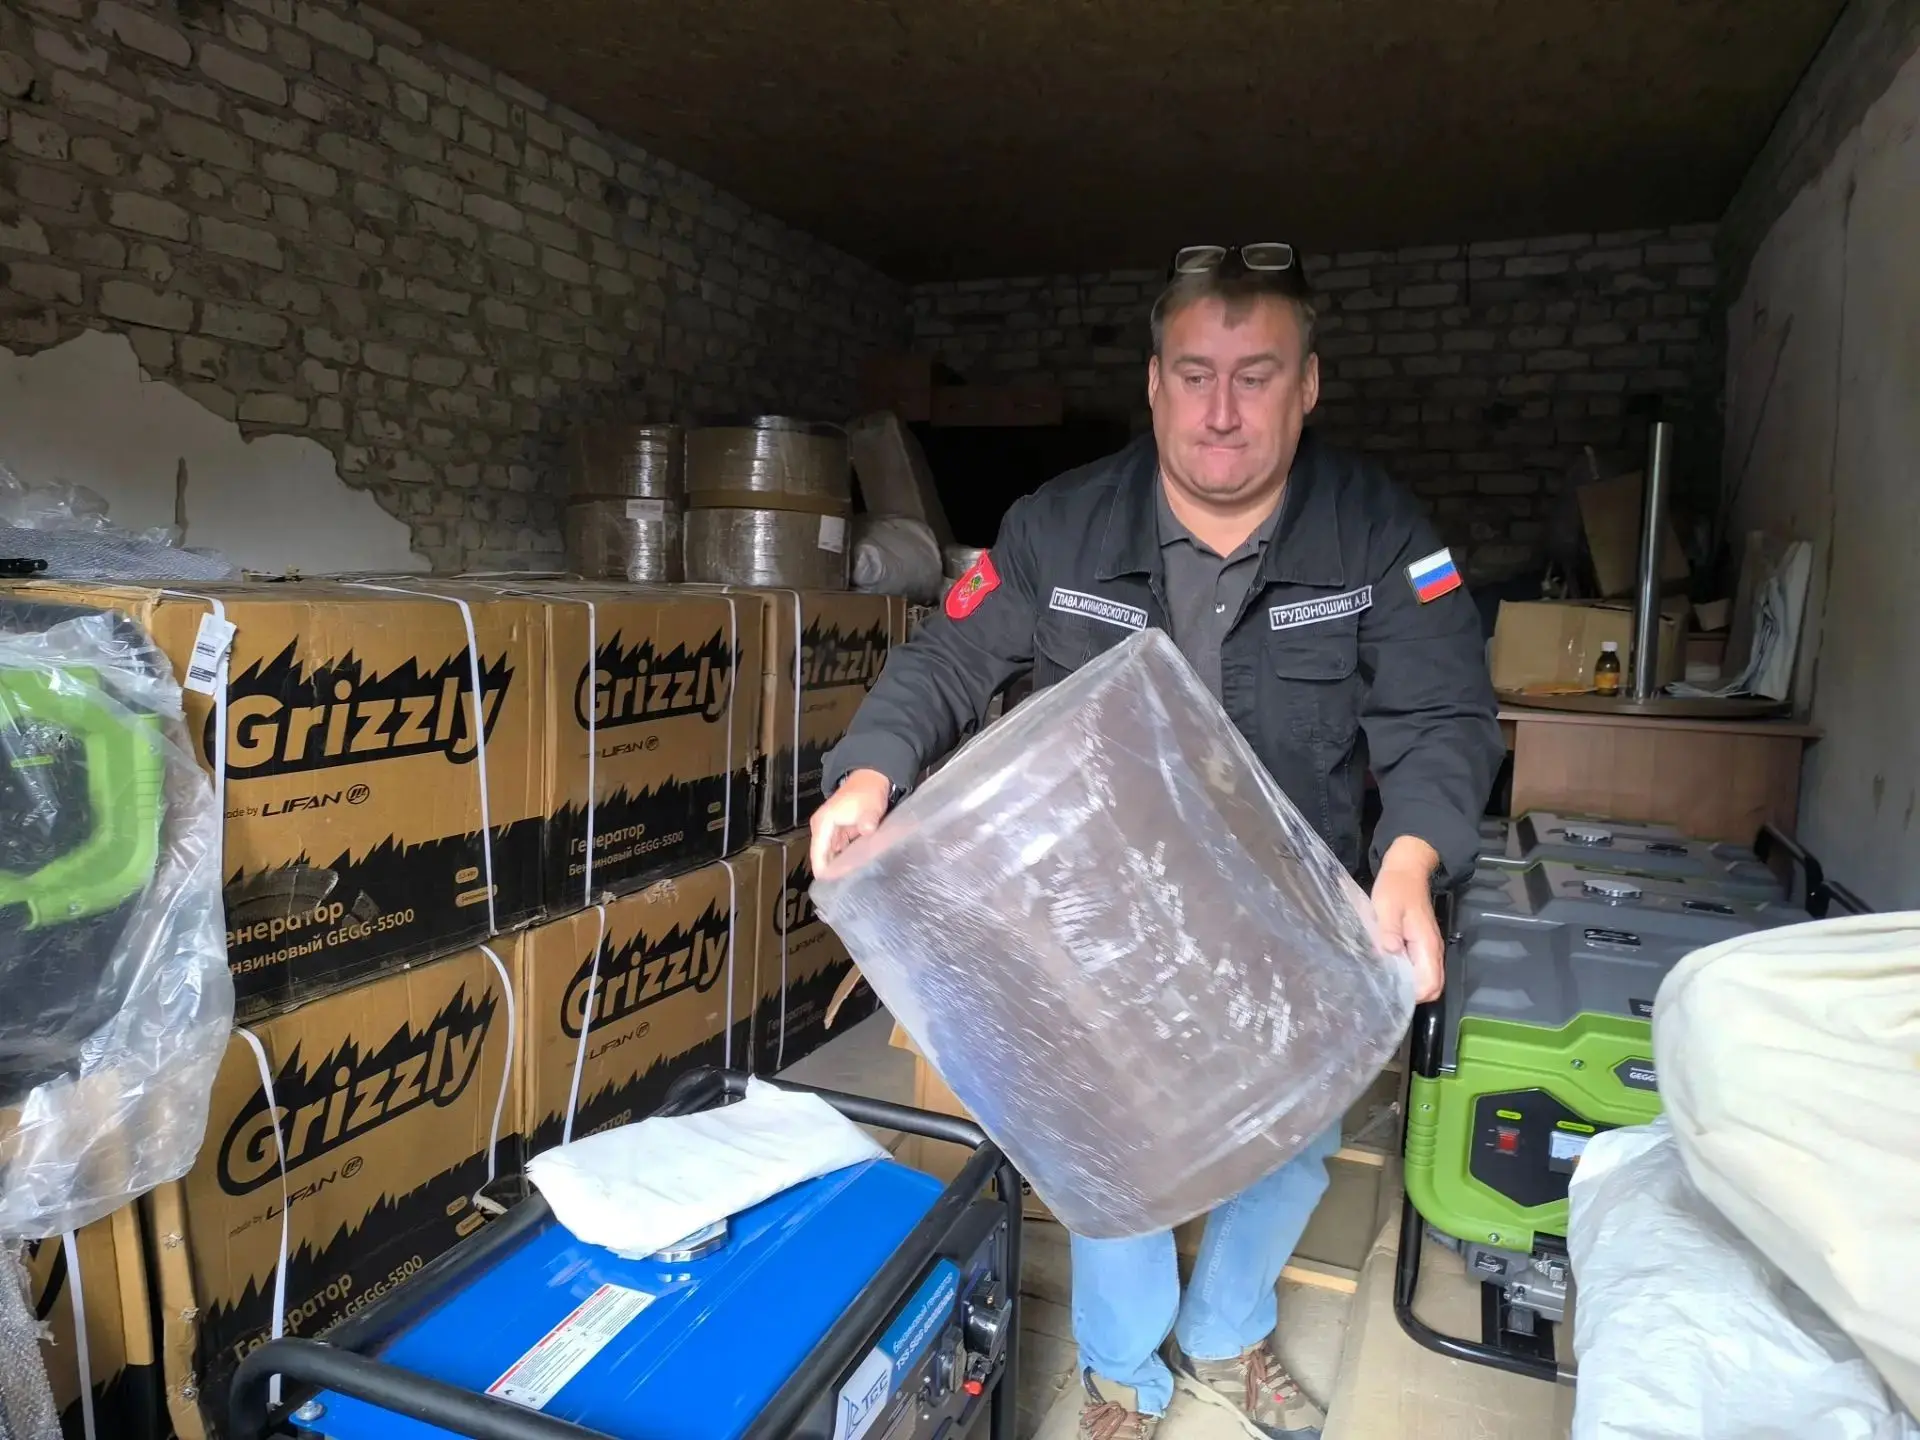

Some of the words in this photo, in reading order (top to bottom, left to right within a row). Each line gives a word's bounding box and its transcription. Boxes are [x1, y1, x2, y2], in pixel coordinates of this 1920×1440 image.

[1273, 597, 1353, 625] ТРУДОНОШИН
[793, 639, 888, 687] Grizzly
[580, 656, 733, 723] Grizzly
[226, 676, 500, 768] Grizzly
[601, 740, 644, 758] LIFAN
[262, 791, 343, 817] LIFAN
[568, 846, 633, 876] Бениновый
[634, 831, 685, 856] GEGG-5500
[570, 824, 646, 855] Геератор
[225, 901, 344, 949] енератор
[230, 935, 323, 977] нзиновый
[326, 908, 415, 946] GEGG-5500
[567, 929, 729, 1030] Grizzly
[590, 1030, 634, 1060] LIFAN
[227, 1023, 483, 1185] Grizzly
[345, 1255, 424, 1320] GEGG-5500
